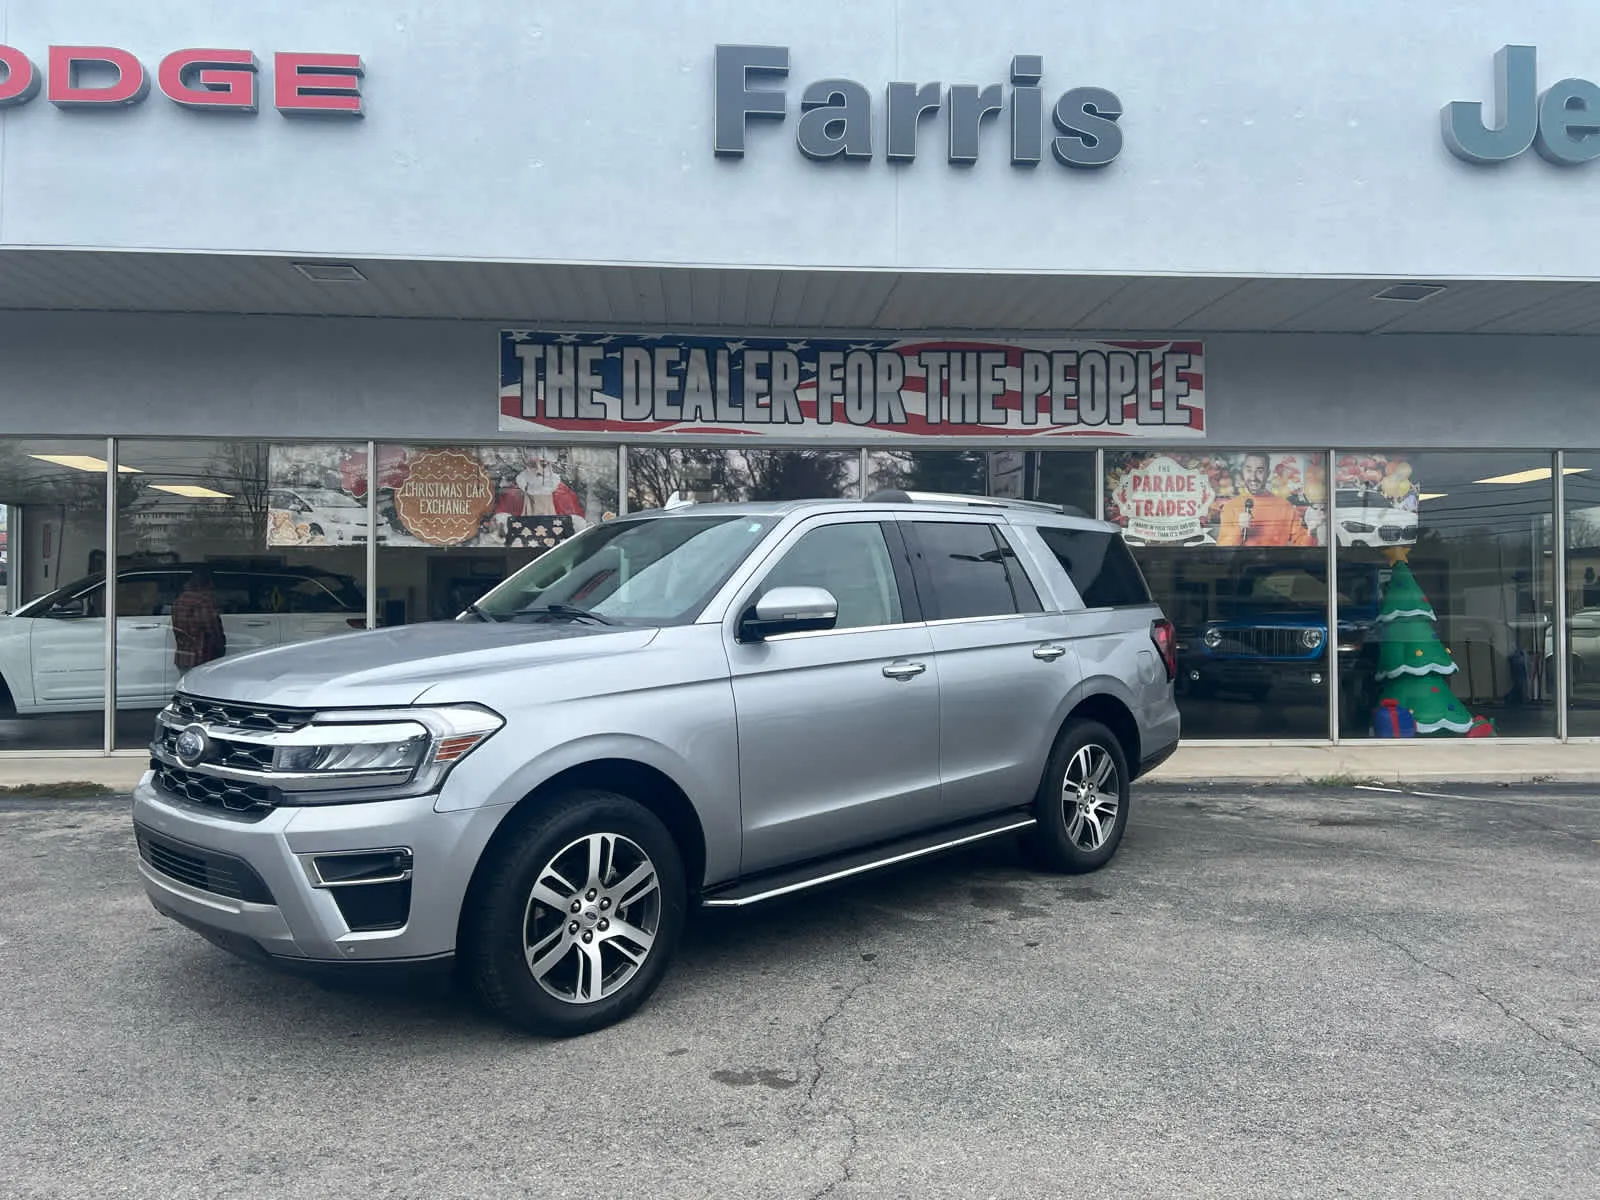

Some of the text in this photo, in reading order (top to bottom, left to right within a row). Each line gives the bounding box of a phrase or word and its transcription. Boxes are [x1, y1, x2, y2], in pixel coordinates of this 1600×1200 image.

[714, 44, 1123, 167] Farris
[1440, 44, 1600, 165] Je
[514, 344, 1193, 426] THE DEALER FOR THE PEOPLE
[405, 481, 486, 498] CHRISTMAS CAR
[1132, 474, 1197, 493] PARADE
[420, 499, 472, 515] EXCHANGE
[1132, 499, 1197, 517] TRADES
